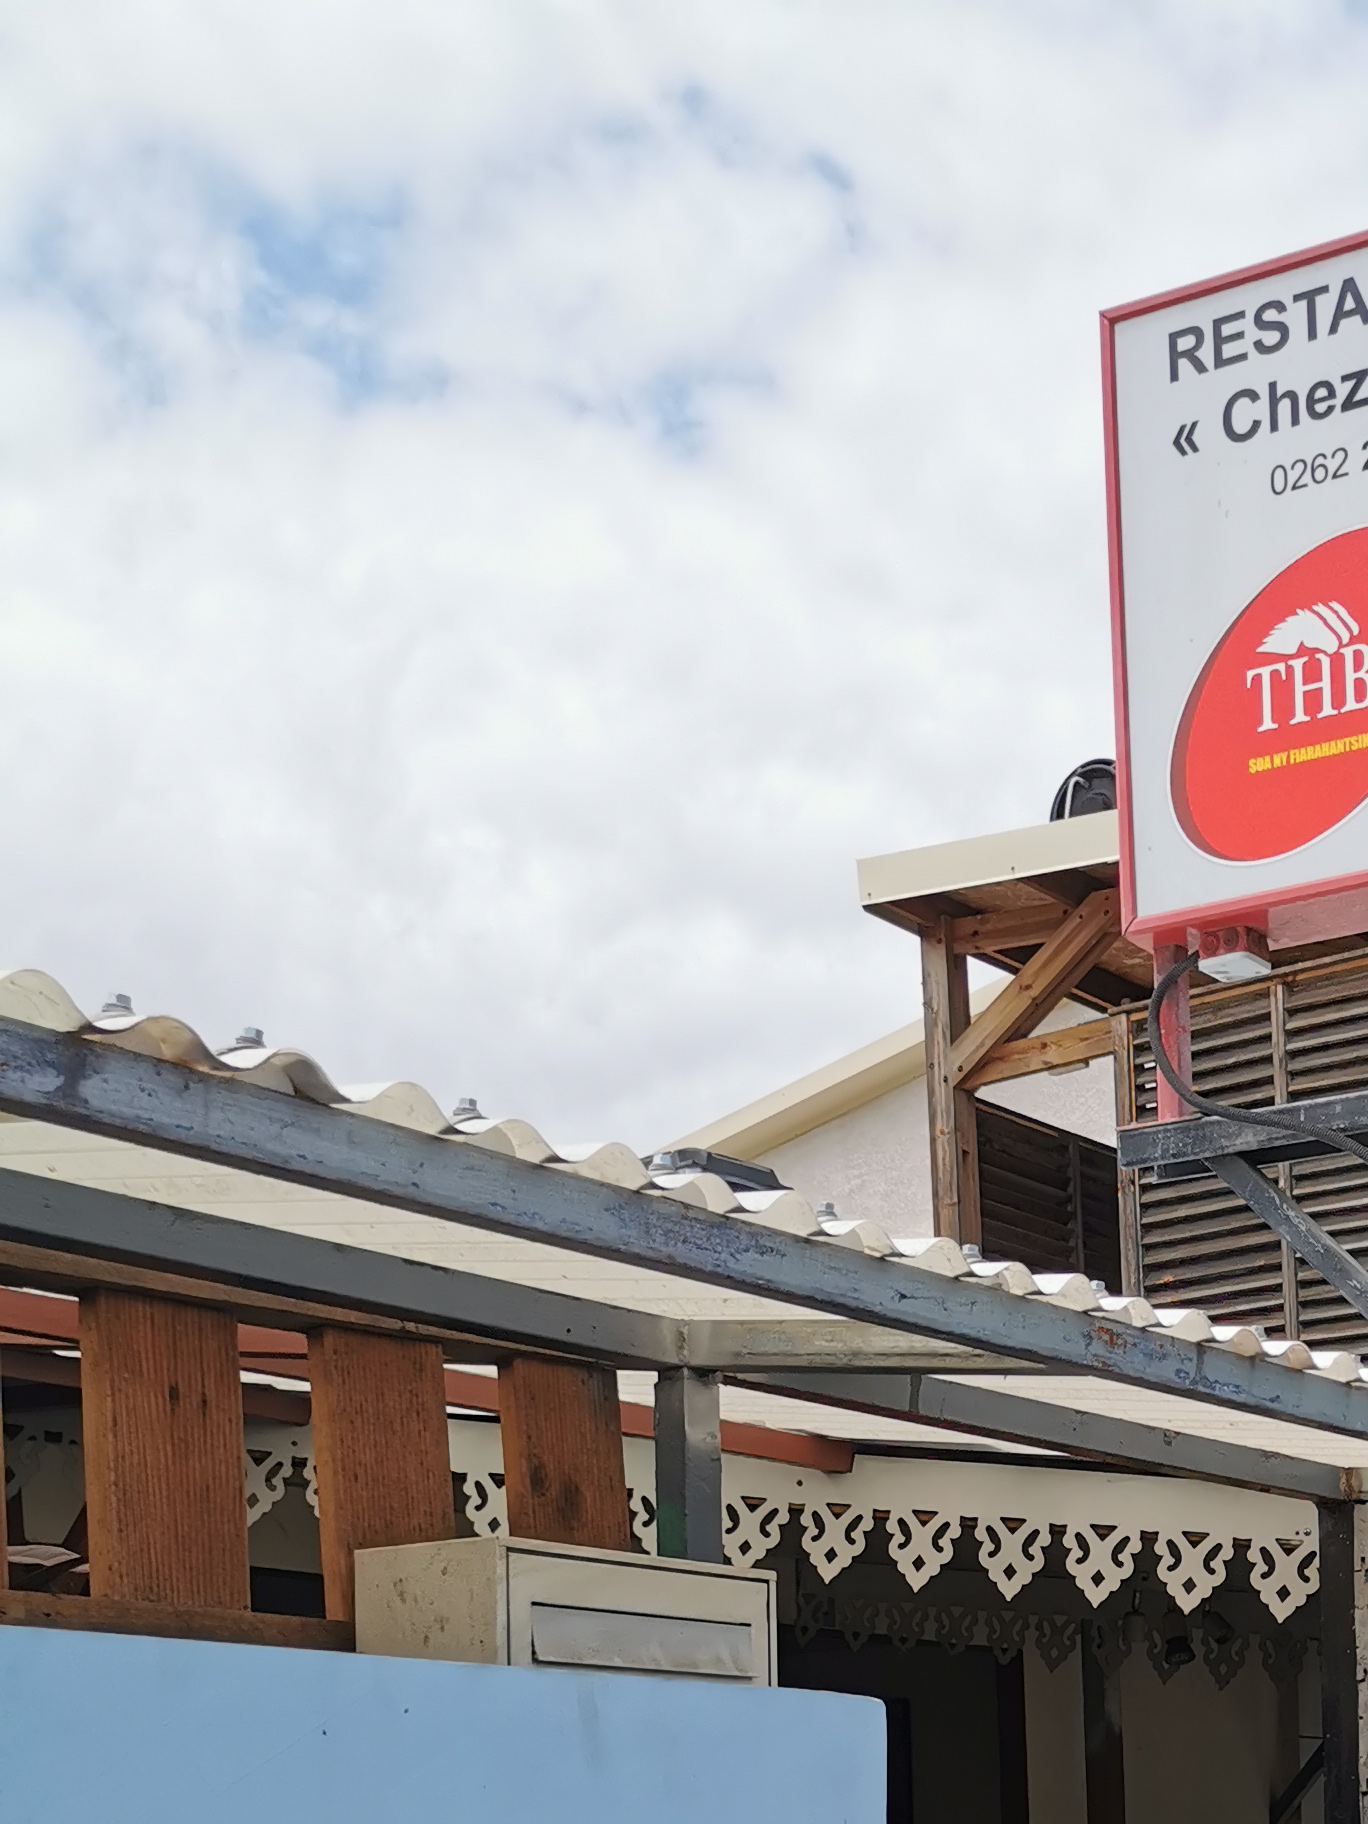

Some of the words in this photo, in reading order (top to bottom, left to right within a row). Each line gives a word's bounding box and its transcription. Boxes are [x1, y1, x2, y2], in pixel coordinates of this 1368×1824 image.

[1269, 448, 1350, 497] 0262
[1248, 755, 1272, 774] SOA
[1272, 751, 1289, 769] NY
